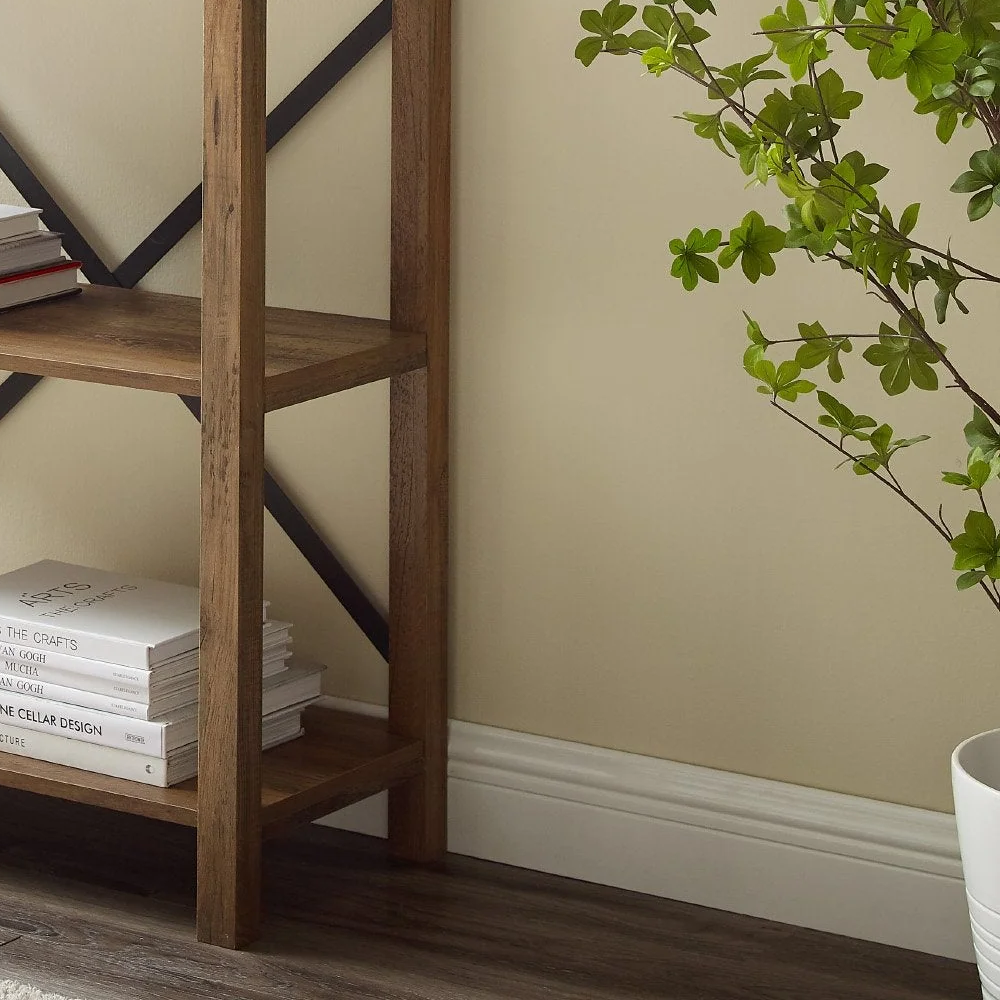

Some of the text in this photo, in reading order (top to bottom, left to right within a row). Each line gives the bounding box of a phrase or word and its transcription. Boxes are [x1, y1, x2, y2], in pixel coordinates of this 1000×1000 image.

[7, 626, 28, 641] THE
[33, 632, 78, 651] CRAFTS
[19, 649, 46, 664] GOGH
[5, 661, 39, 677] MUCHA
[16, 680, 44, 695] GOGH
[17, 707, 56, 726] CELLAR
[60, 717, 102, 736] DESIGN
